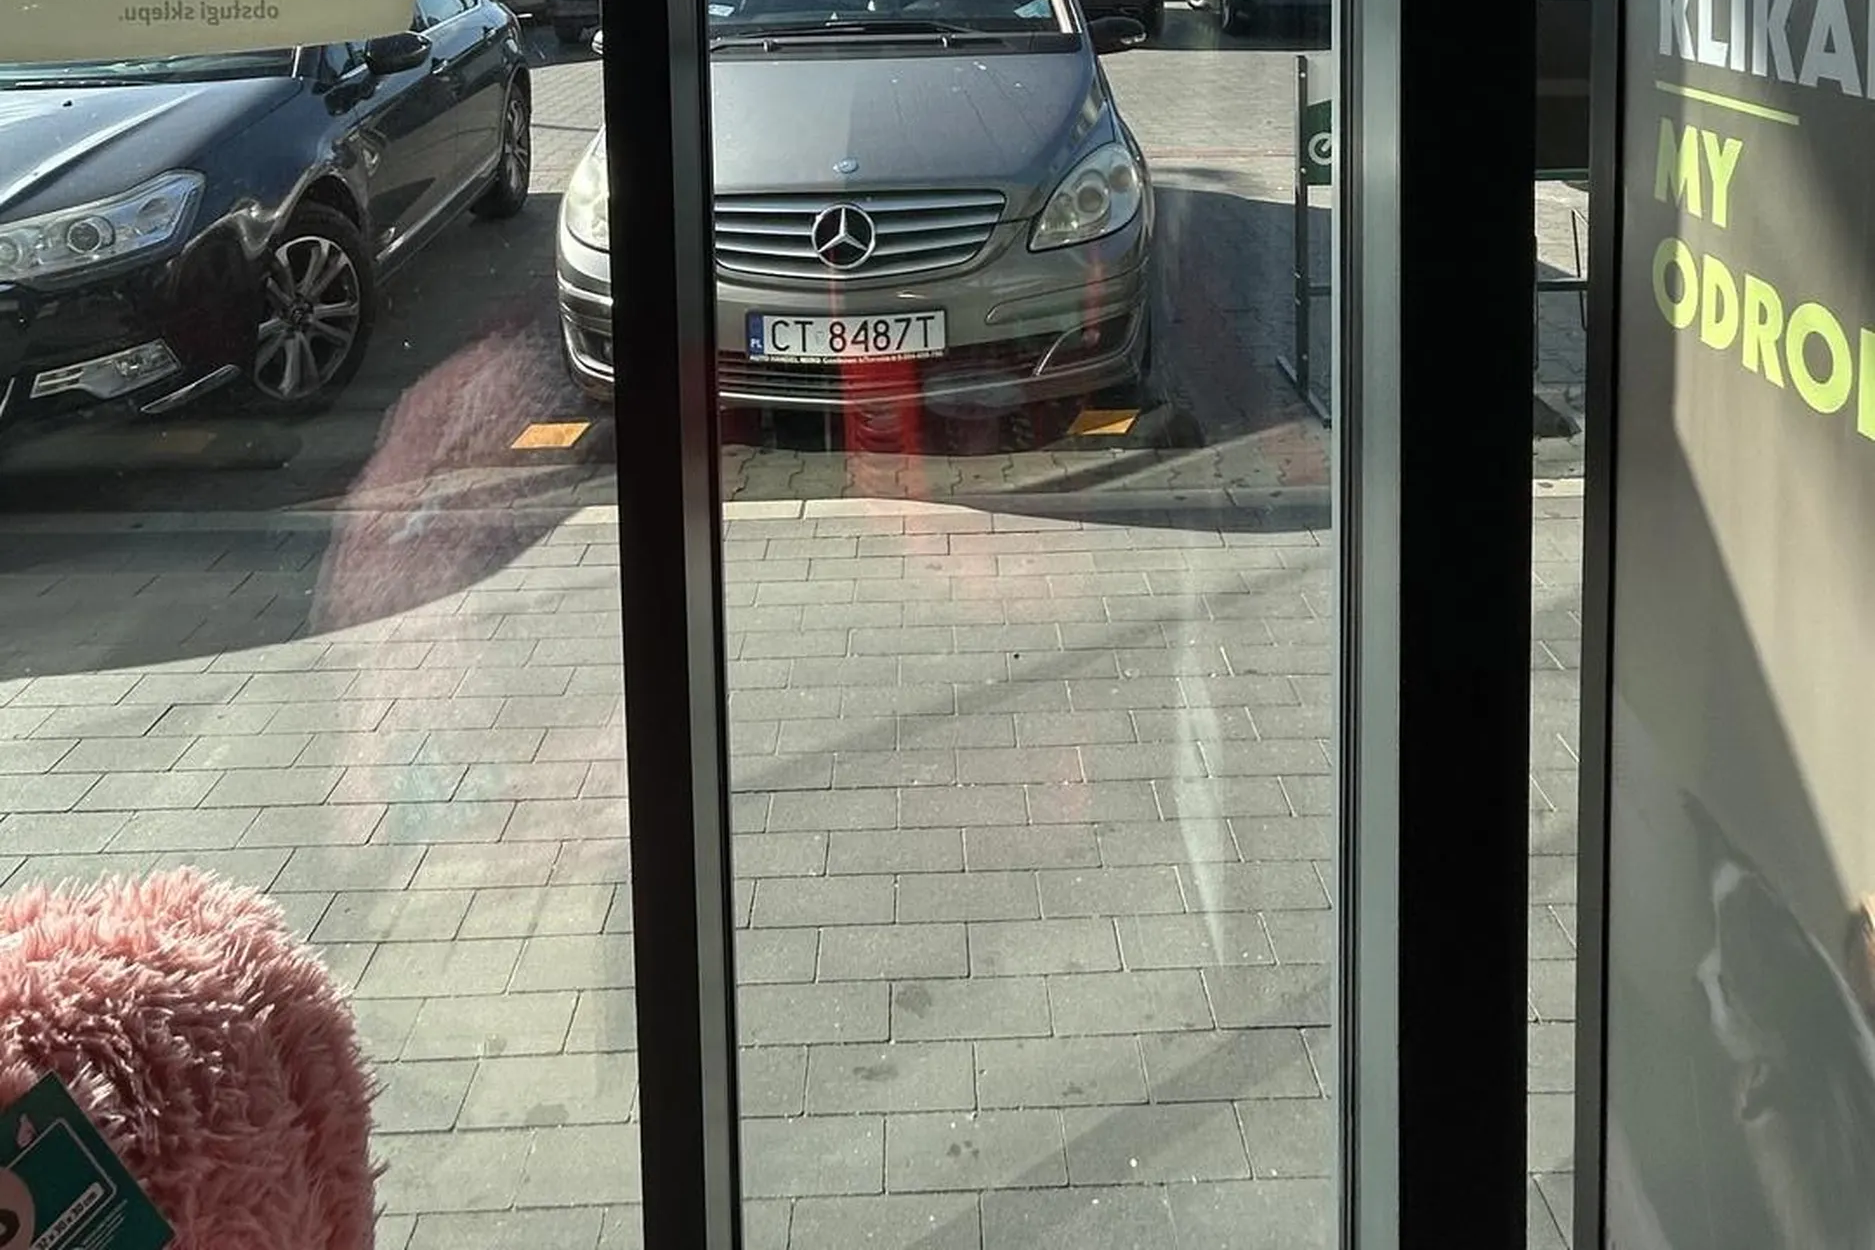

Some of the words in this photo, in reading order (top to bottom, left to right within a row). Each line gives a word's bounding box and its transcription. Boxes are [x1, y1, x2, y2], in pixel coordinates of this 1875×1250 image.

[1653, 116, 1743, 230] MY
[750, 338, 763, 349] PL
[771, 319, 814, 352] CT
[828, 315, 936, 353] 8487T
